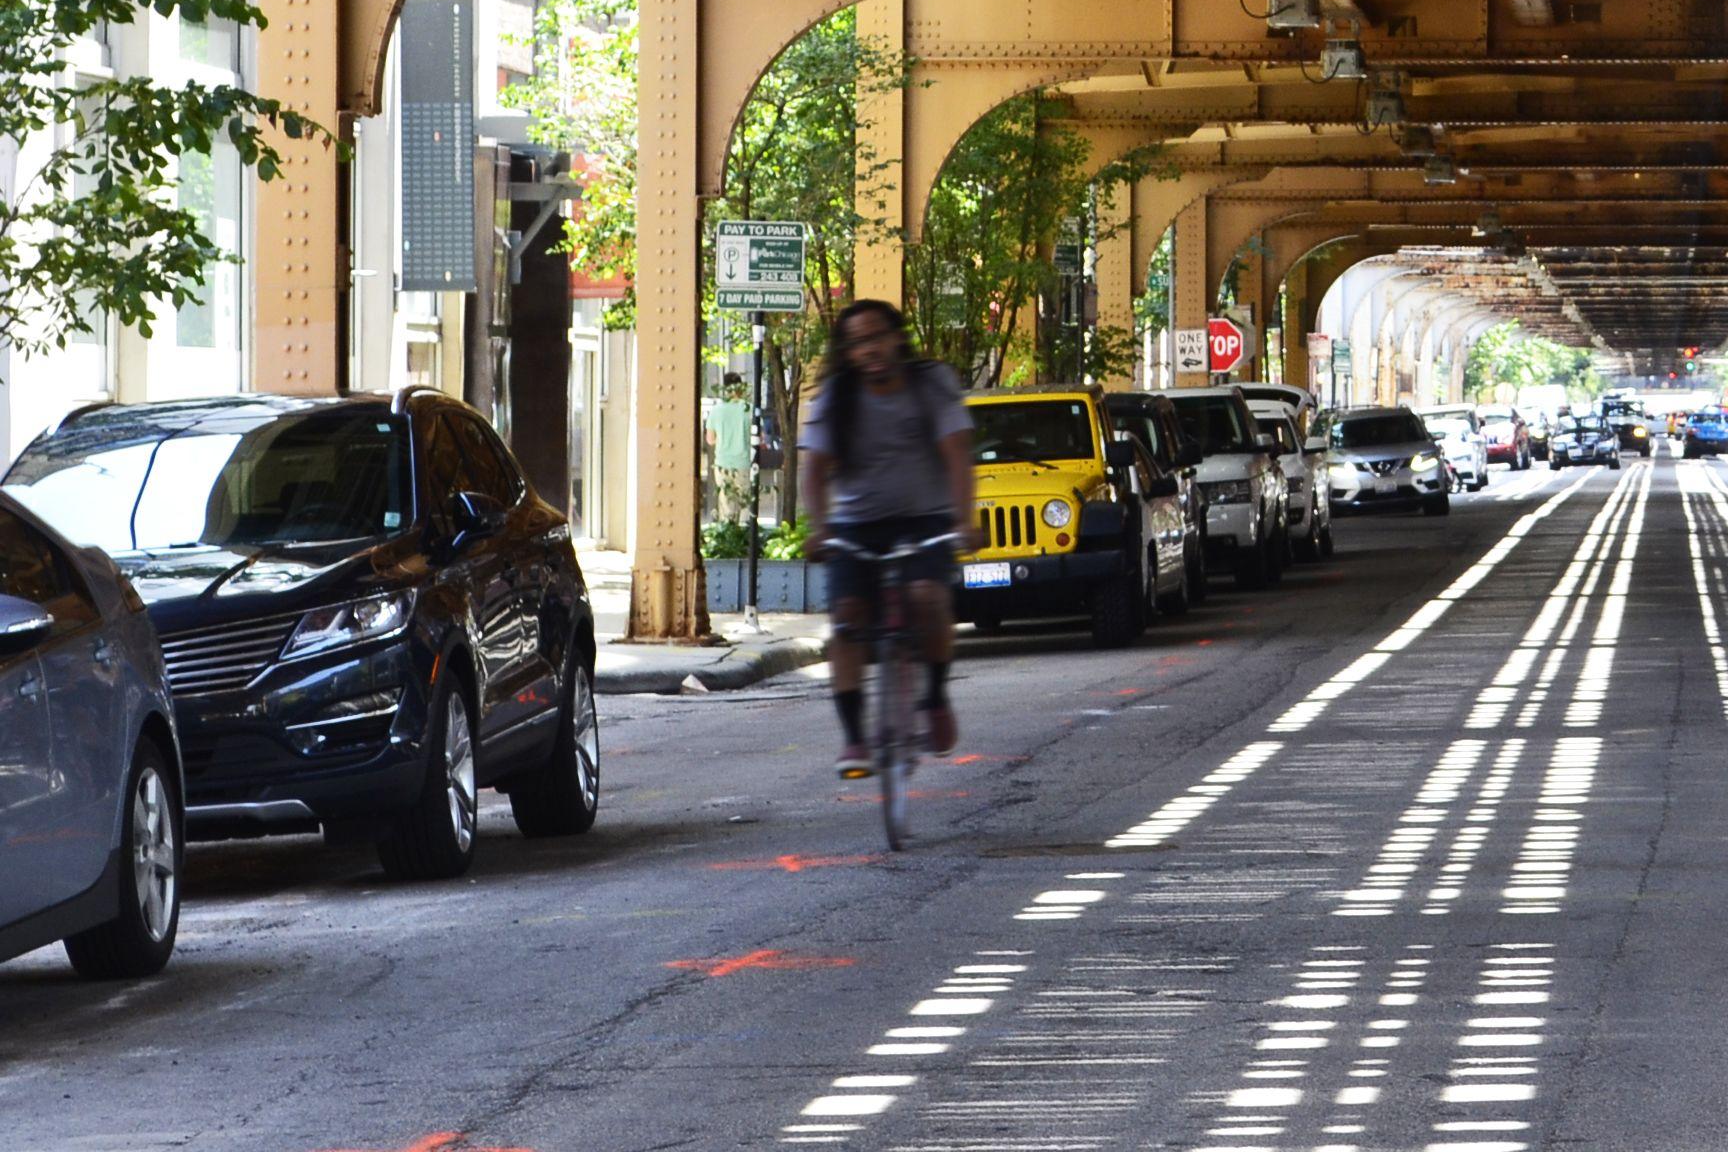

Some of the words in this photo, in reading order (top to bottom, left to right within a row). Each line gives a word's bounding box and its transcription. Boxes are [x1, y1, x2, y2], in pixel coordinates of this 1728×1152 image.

[724, 225, 745, 234] PAY
[749, 225, 764, 235] TO
[766, 226, 797, 235] PARK
[760, 273, 778, 281] 243
[720, 294, 725, 303] 7
[726, 294, 742, 303] DAY
[744, 294, 763, 303] PAID
[764, 294, 800, 304] PARKING
[1178, 333, 1203, 343] ONE
[1178, 345, 1203, 355] WAY
